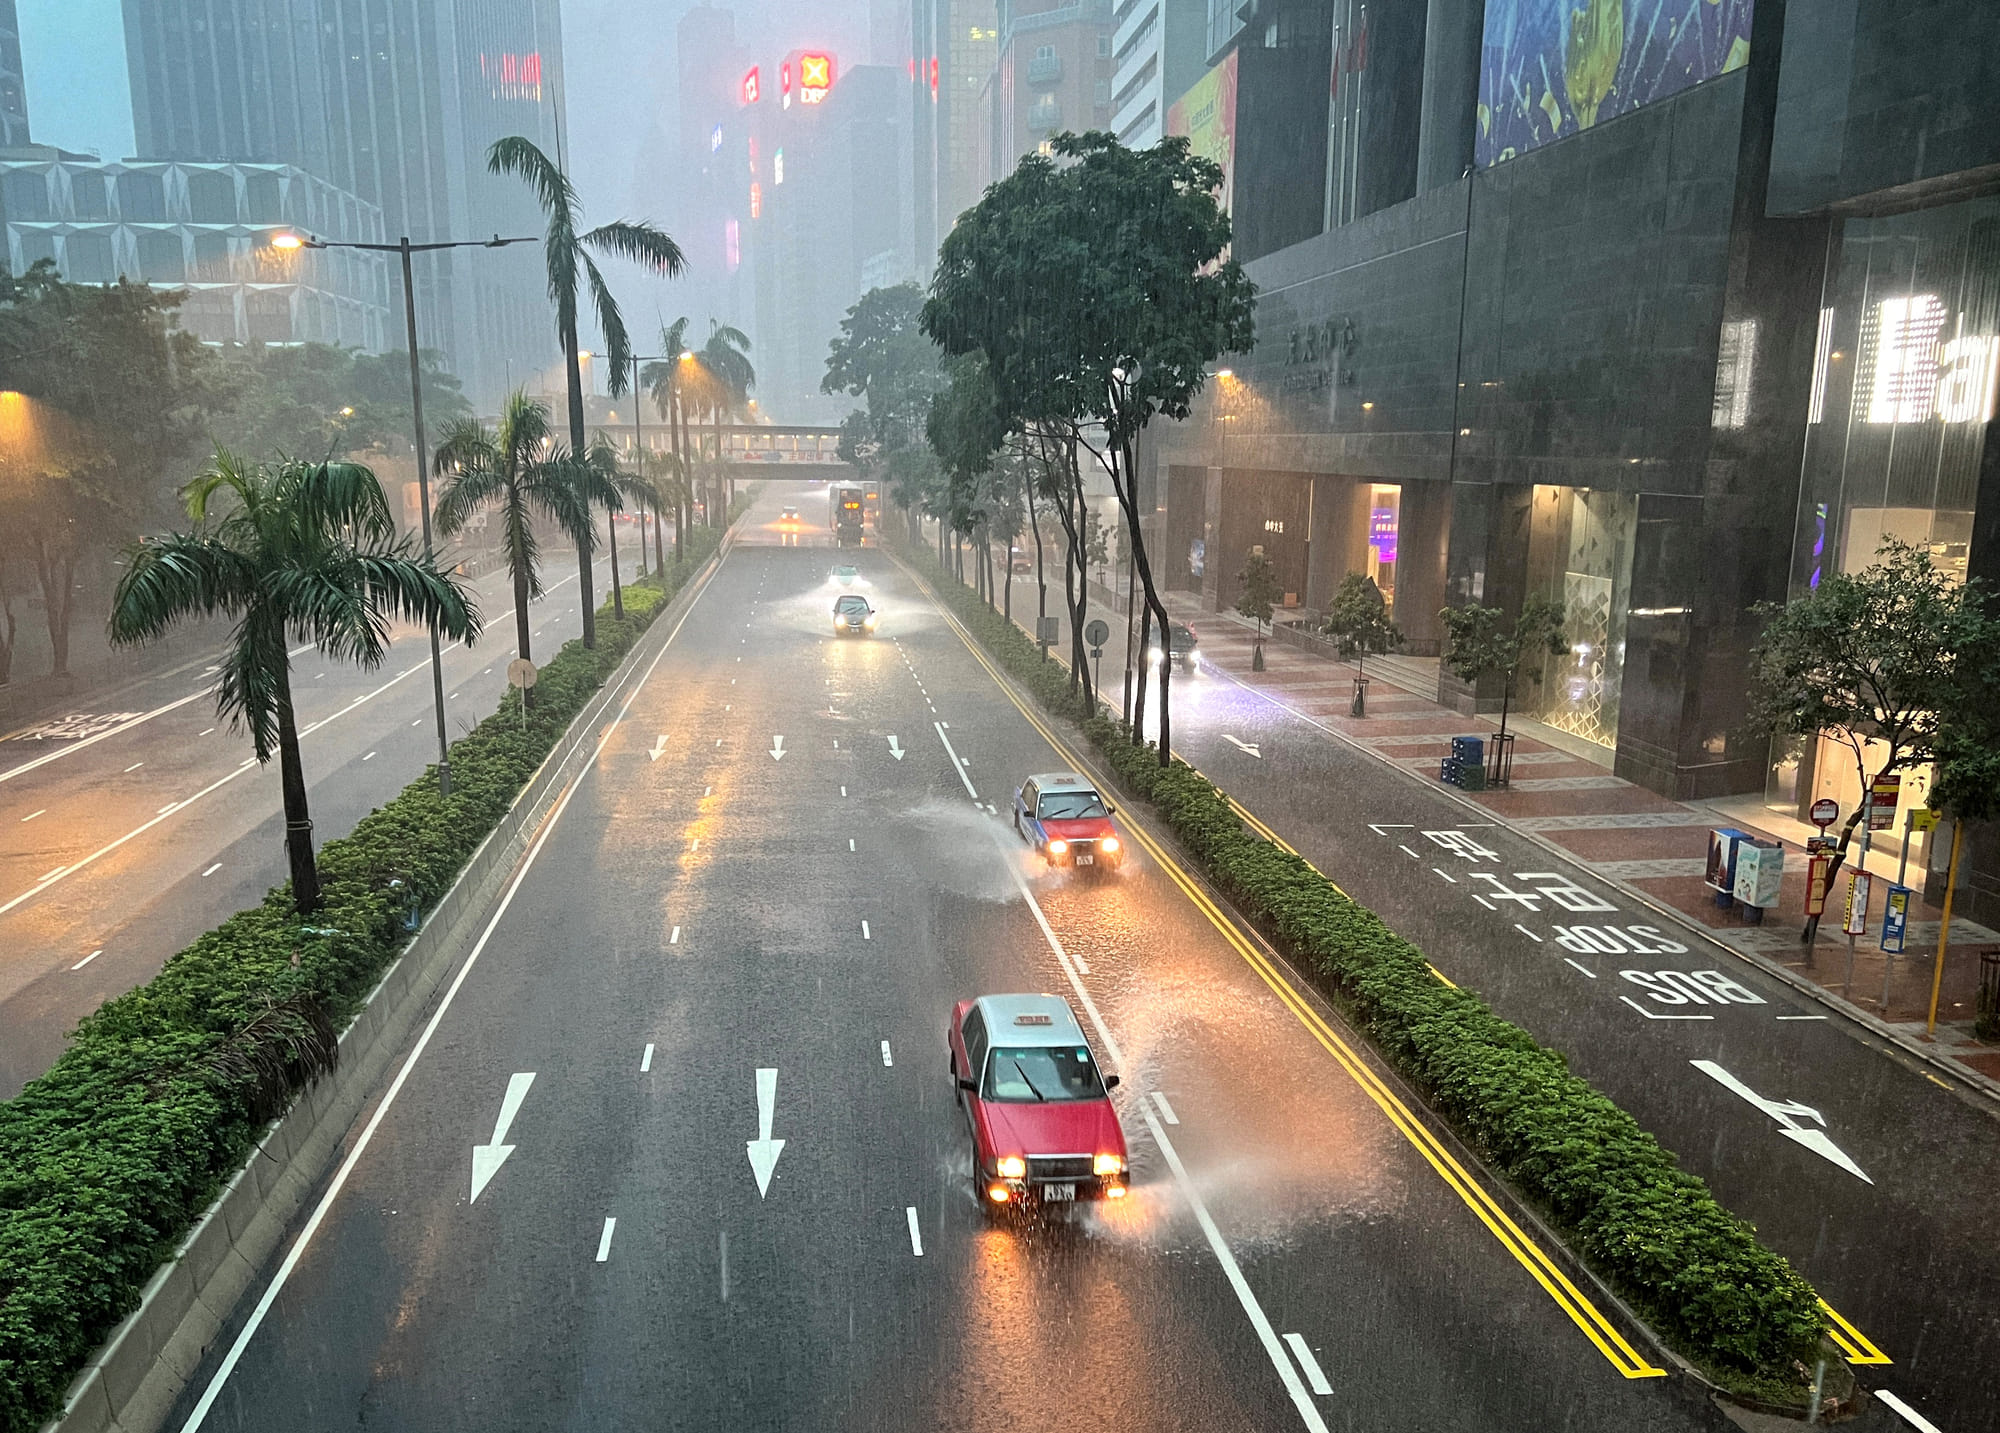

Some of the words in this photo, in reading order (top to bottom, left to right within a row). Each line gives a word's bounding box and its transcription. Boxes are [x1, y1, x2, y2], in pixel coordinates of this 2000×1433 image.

[1468, 872, 1619, 912] 巴士
[1551, 925, 1689, 954] STOP
[1618, 969, 1768, 1005] BUS
